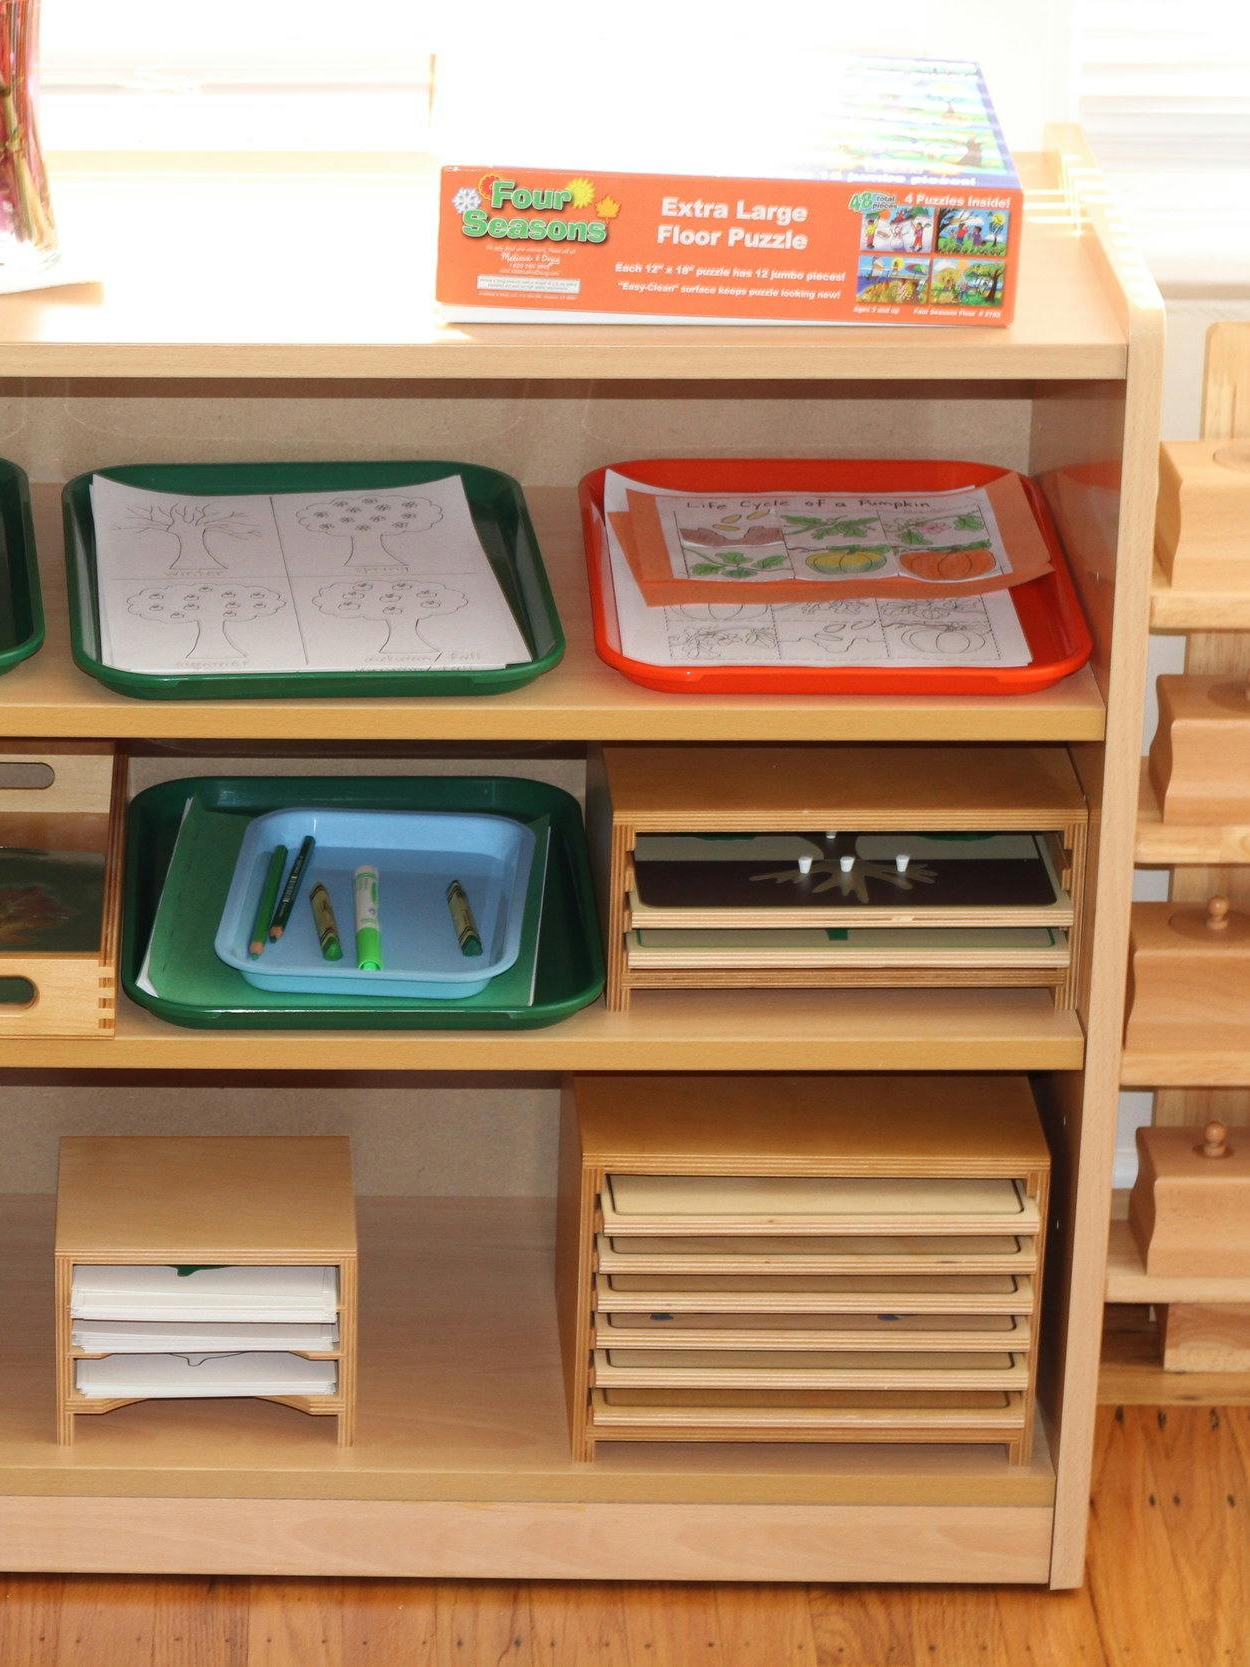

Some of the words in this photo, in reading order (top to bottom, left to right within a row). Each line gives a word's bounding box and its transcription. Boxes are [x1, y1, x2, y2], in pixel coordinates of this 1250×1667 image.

[490, 179, 574, 211] Four
[849, 190, 872, 213] 48
[904, 193, 914, 205] 4
[916, 194, 965, 208] Puzzles
[967, 197, 1012, 210] Inside!
[661, 196, 729, 219] Extra
[736, 199, 809, 226] Large
[462, 208, 608, 244] Seasons
[657, 223, 722, 246] Floor
[727, 226, 809, 251] Puzzle
[614, 262, 643, 274] Each
[695, 267, 730, 279] puzzle
[732, 268, 752, 279] has
[755, 269, 769, 279] 12
[770, 270, 804, 282] jumbo
[806, 272, 847, 284] pieces!
[680, 284, 717, 295] surface
[718, 286, 748, 298] keeps
[749, 287, 779, 299] puzzle
[780, 289, 815, 301] looking
[739, 500, 789, 510] Cycle
[857, 499, 932, 510] Pumpkin
